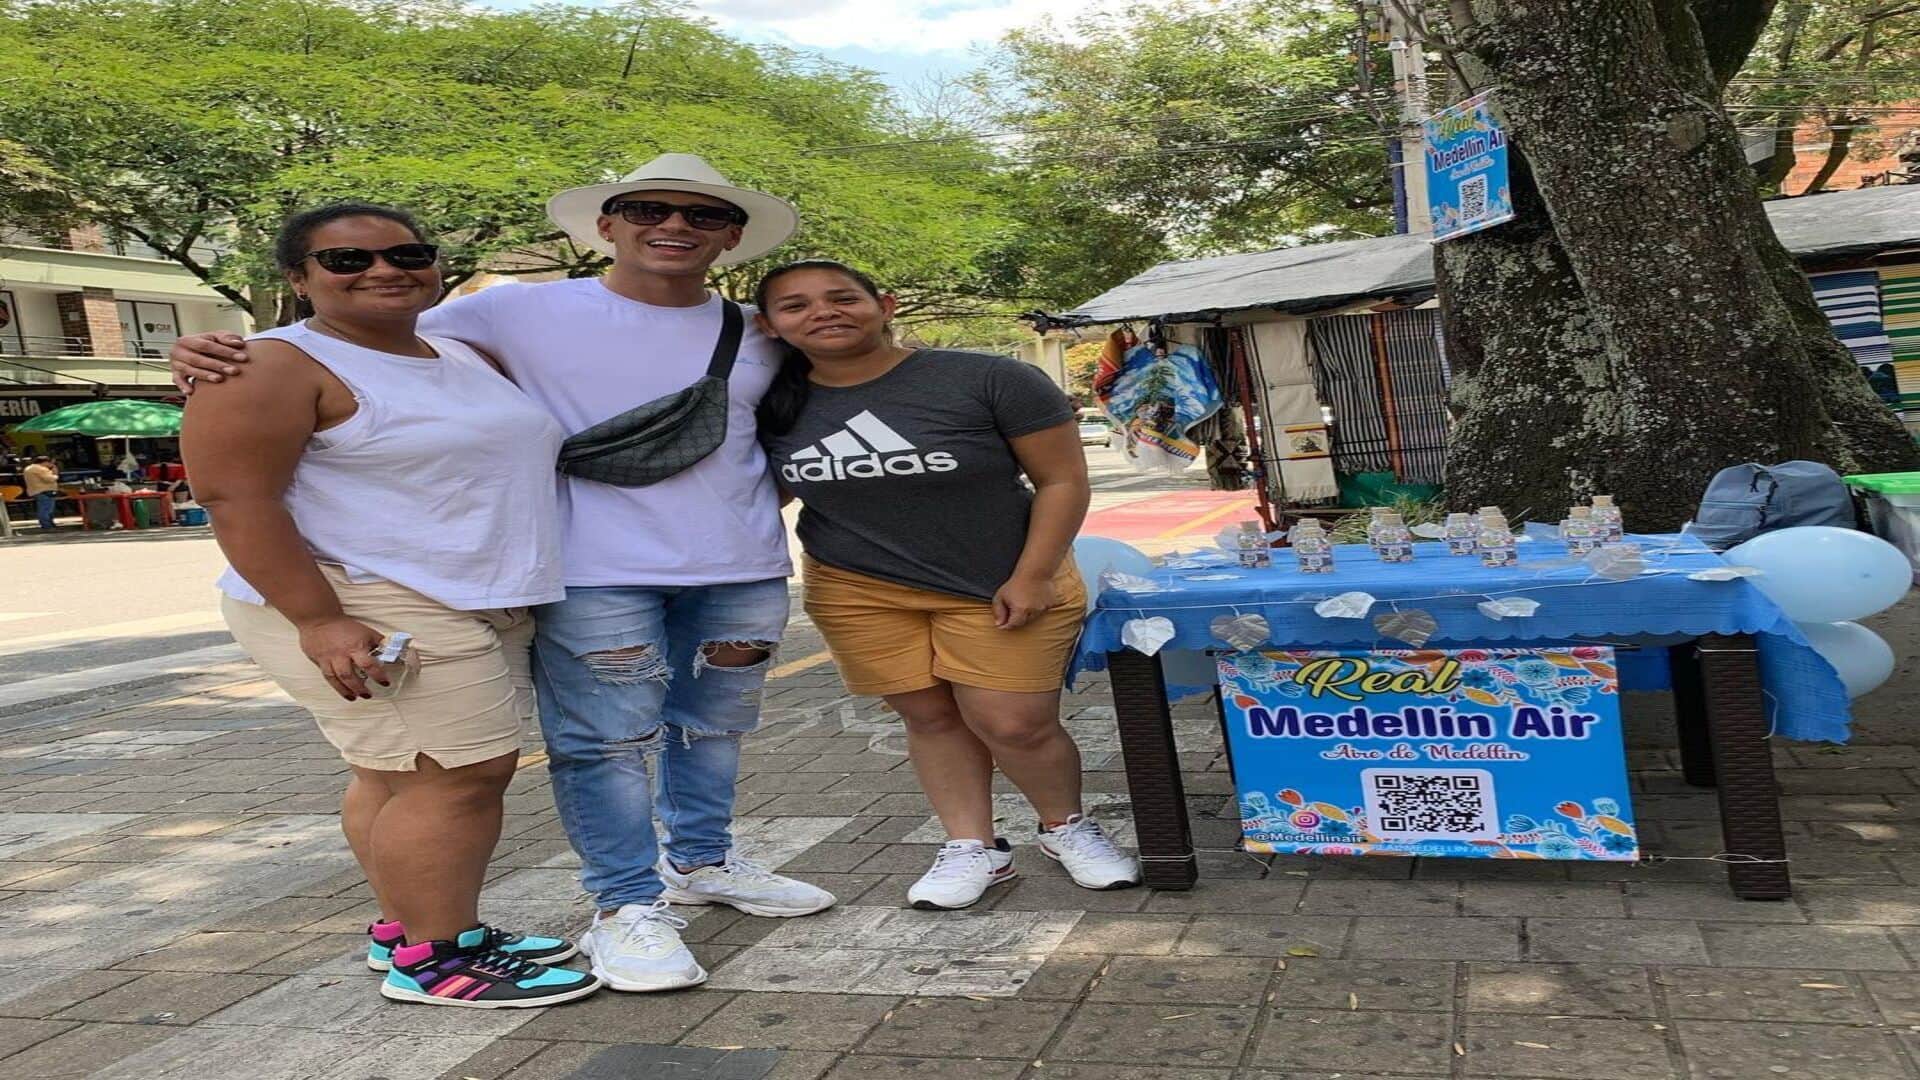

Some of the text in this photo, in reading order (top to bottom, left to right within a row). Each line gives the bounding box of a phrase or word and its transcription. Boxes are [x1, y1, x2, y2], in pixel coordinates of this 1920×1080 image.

[781, 451, 959, 483] adidas
[1294, 656, 1461, 701] Real
[1512, 706, 1596, 738] Air
[1388, 744, 1418, 760] de
